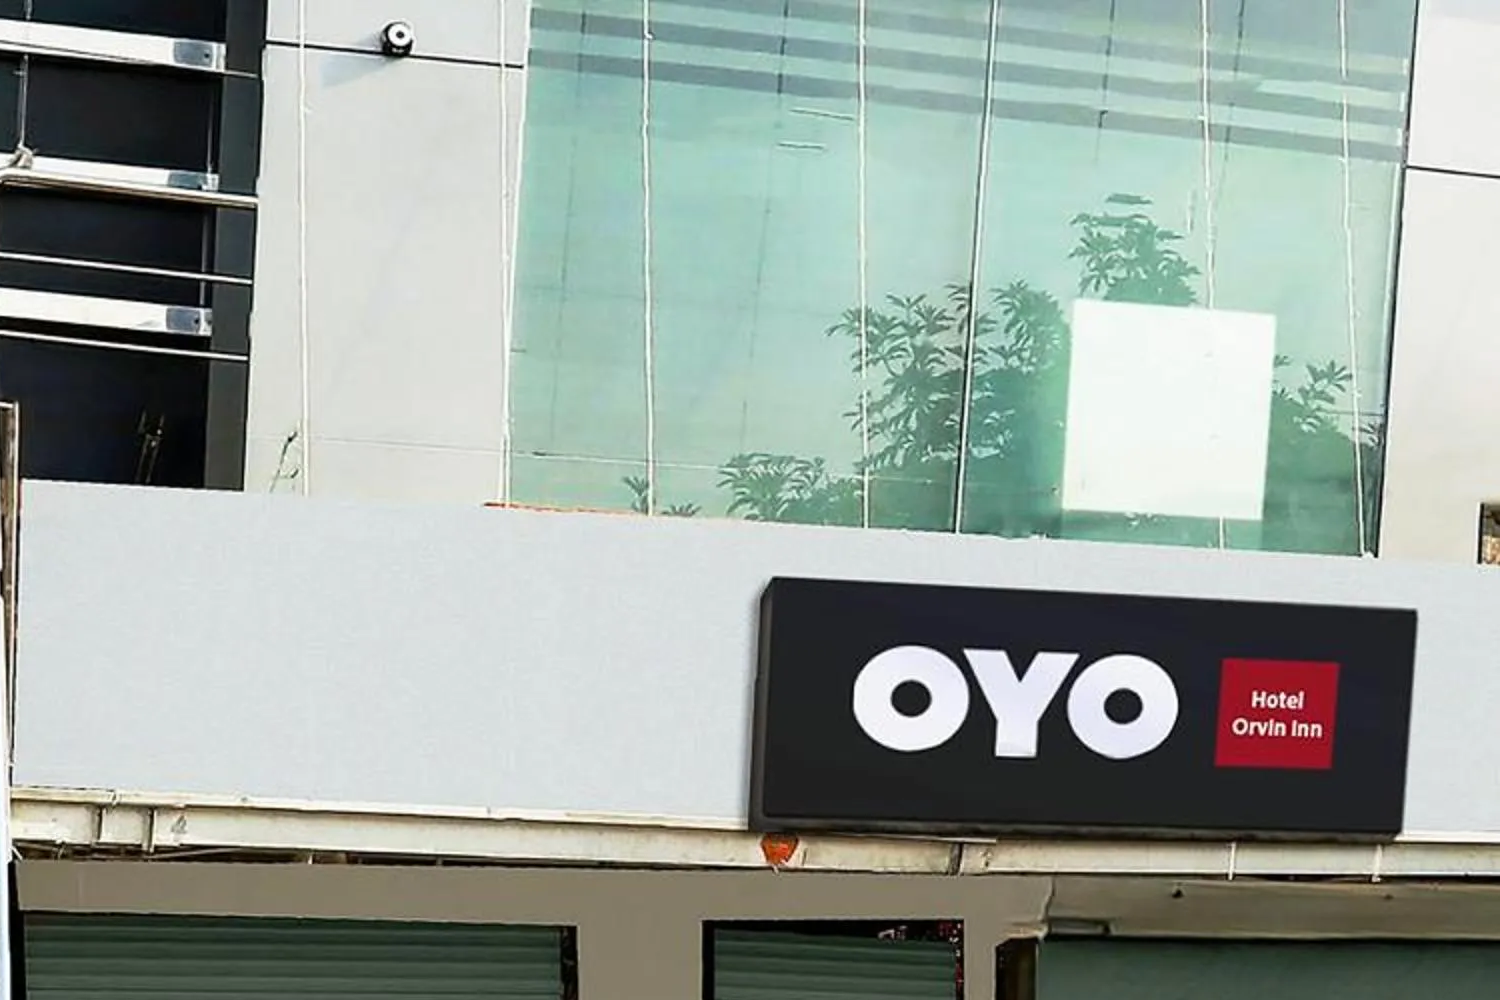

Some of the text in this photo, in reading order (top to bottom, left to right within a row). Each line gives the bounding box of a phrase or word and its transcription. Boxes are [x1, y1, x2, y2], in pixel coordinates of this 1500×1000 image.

[853, 645, 1179, 759] OYO
[1251, 690, 1305, 710] Hotel
[1231, 717, 1323, 739] Orvin Inn
